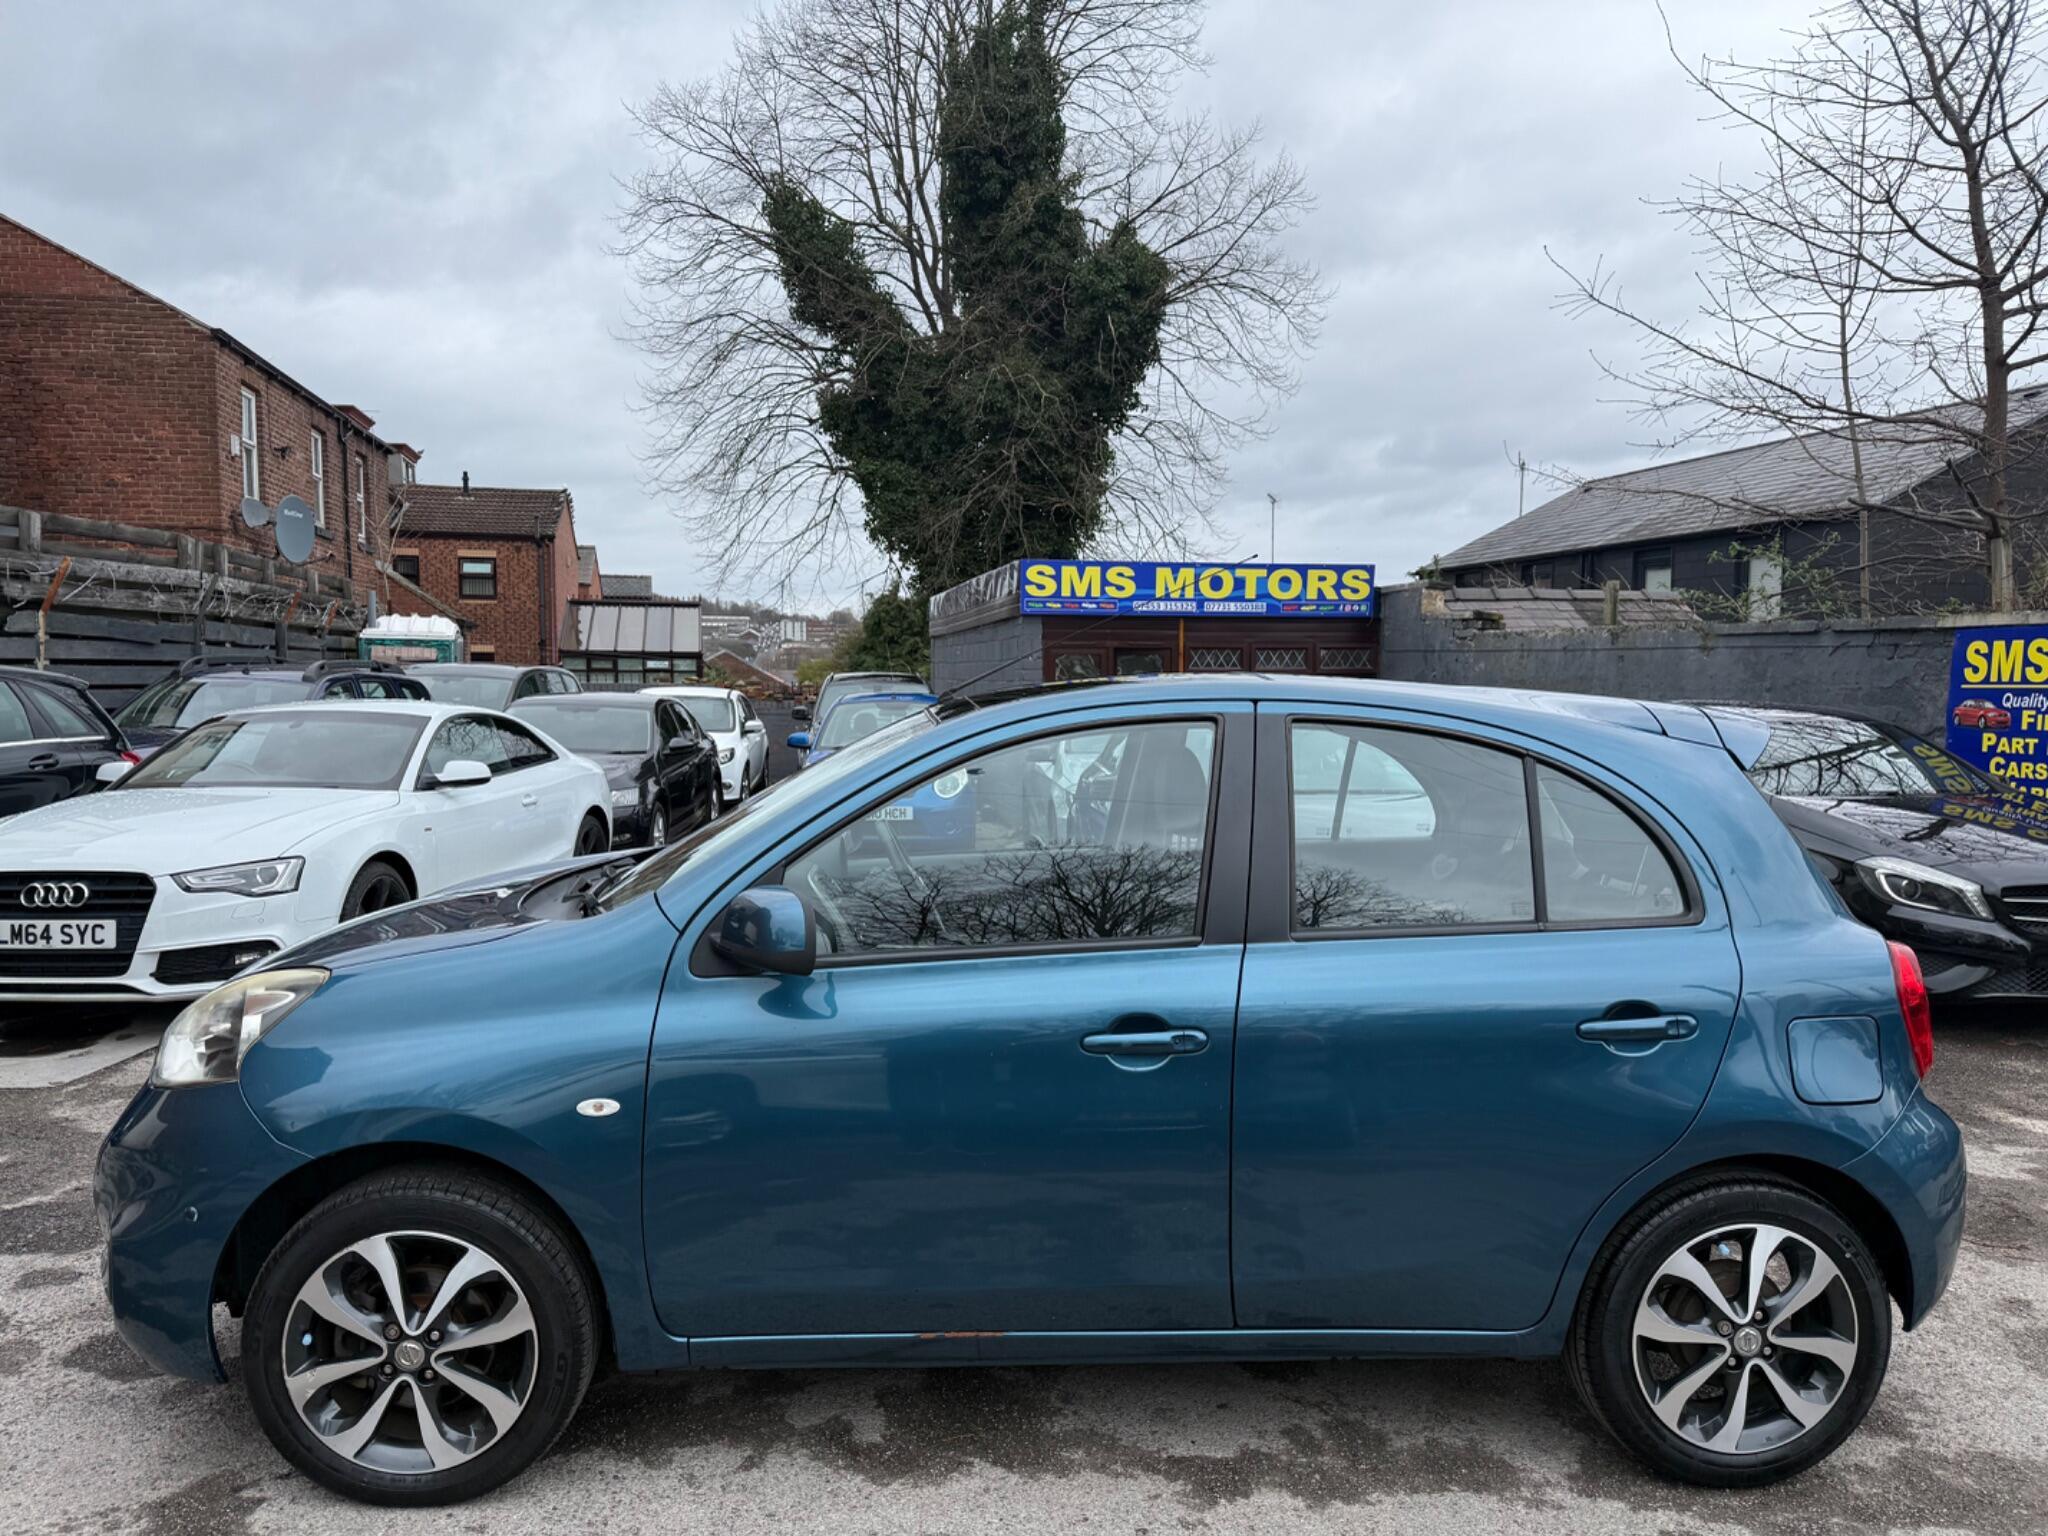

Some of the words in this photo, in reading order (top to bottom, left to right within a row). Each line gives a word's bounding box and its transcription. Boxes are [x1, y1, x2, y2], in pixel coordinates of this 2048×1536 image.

[1024, 564, 1137, 598] SMS
[1155, 566, 1371, 601] MOTORS
[1963, 638, 2048, 683] SMS
[2001, 692, 2048, 712] Quality
[2021, 709, 2048, 731] FI
[1982, 732, 2039, 755] PART
[1989, 756, 2048, 780] CARS
[60, 924, 105, 945] SYC
